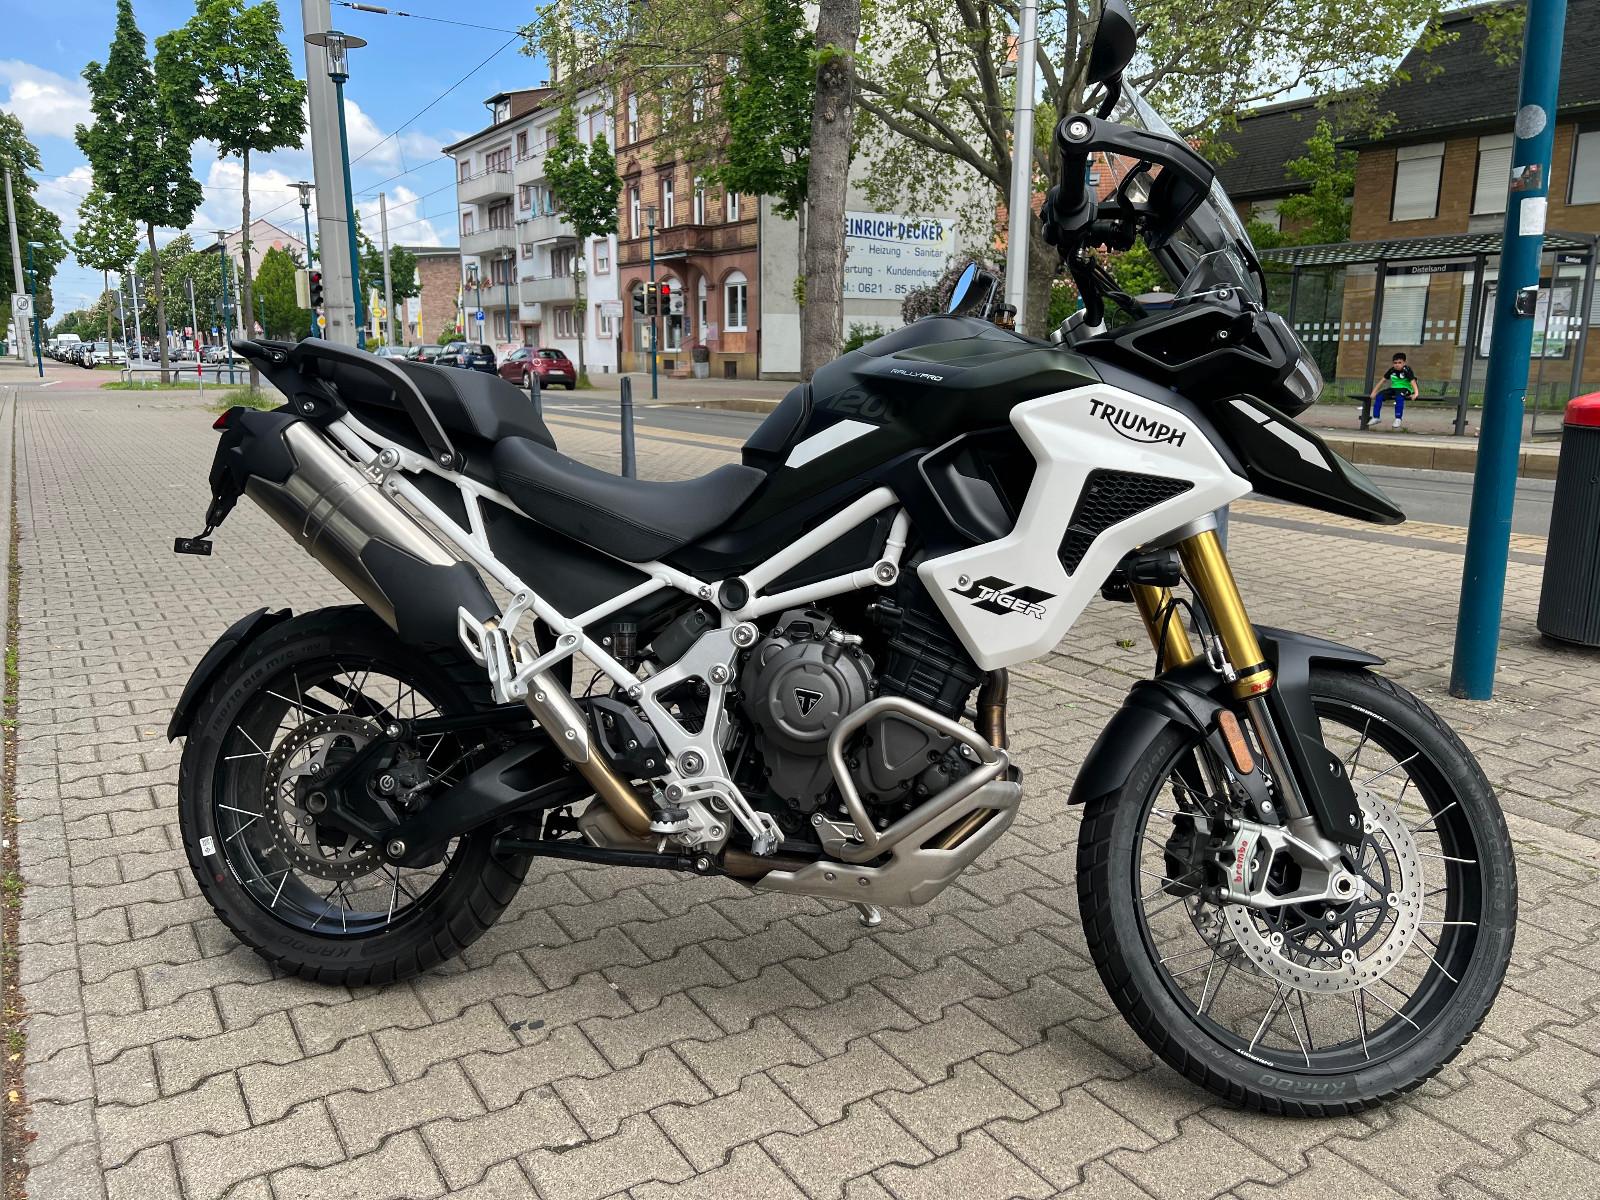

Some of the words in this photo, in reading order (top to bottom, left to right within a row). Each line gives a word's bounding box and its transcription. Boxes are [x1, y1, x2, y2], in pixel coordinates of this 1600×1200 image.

[898, 221, 943, 240] DECKER
[869, 243, 901, 258] Heizung
[1411, 264, 1447, 274] Distelsand
[858, 282, 882, 294] 0621
[894, 284, 907, 294] 85
[1089, 398, 1187, 447] TRIUMPH
[977, 584, 1047, 620] TIGER
[1234, 840, 1248, 882] brembo
[1257, 1074, 1346, 1095] KAROO
